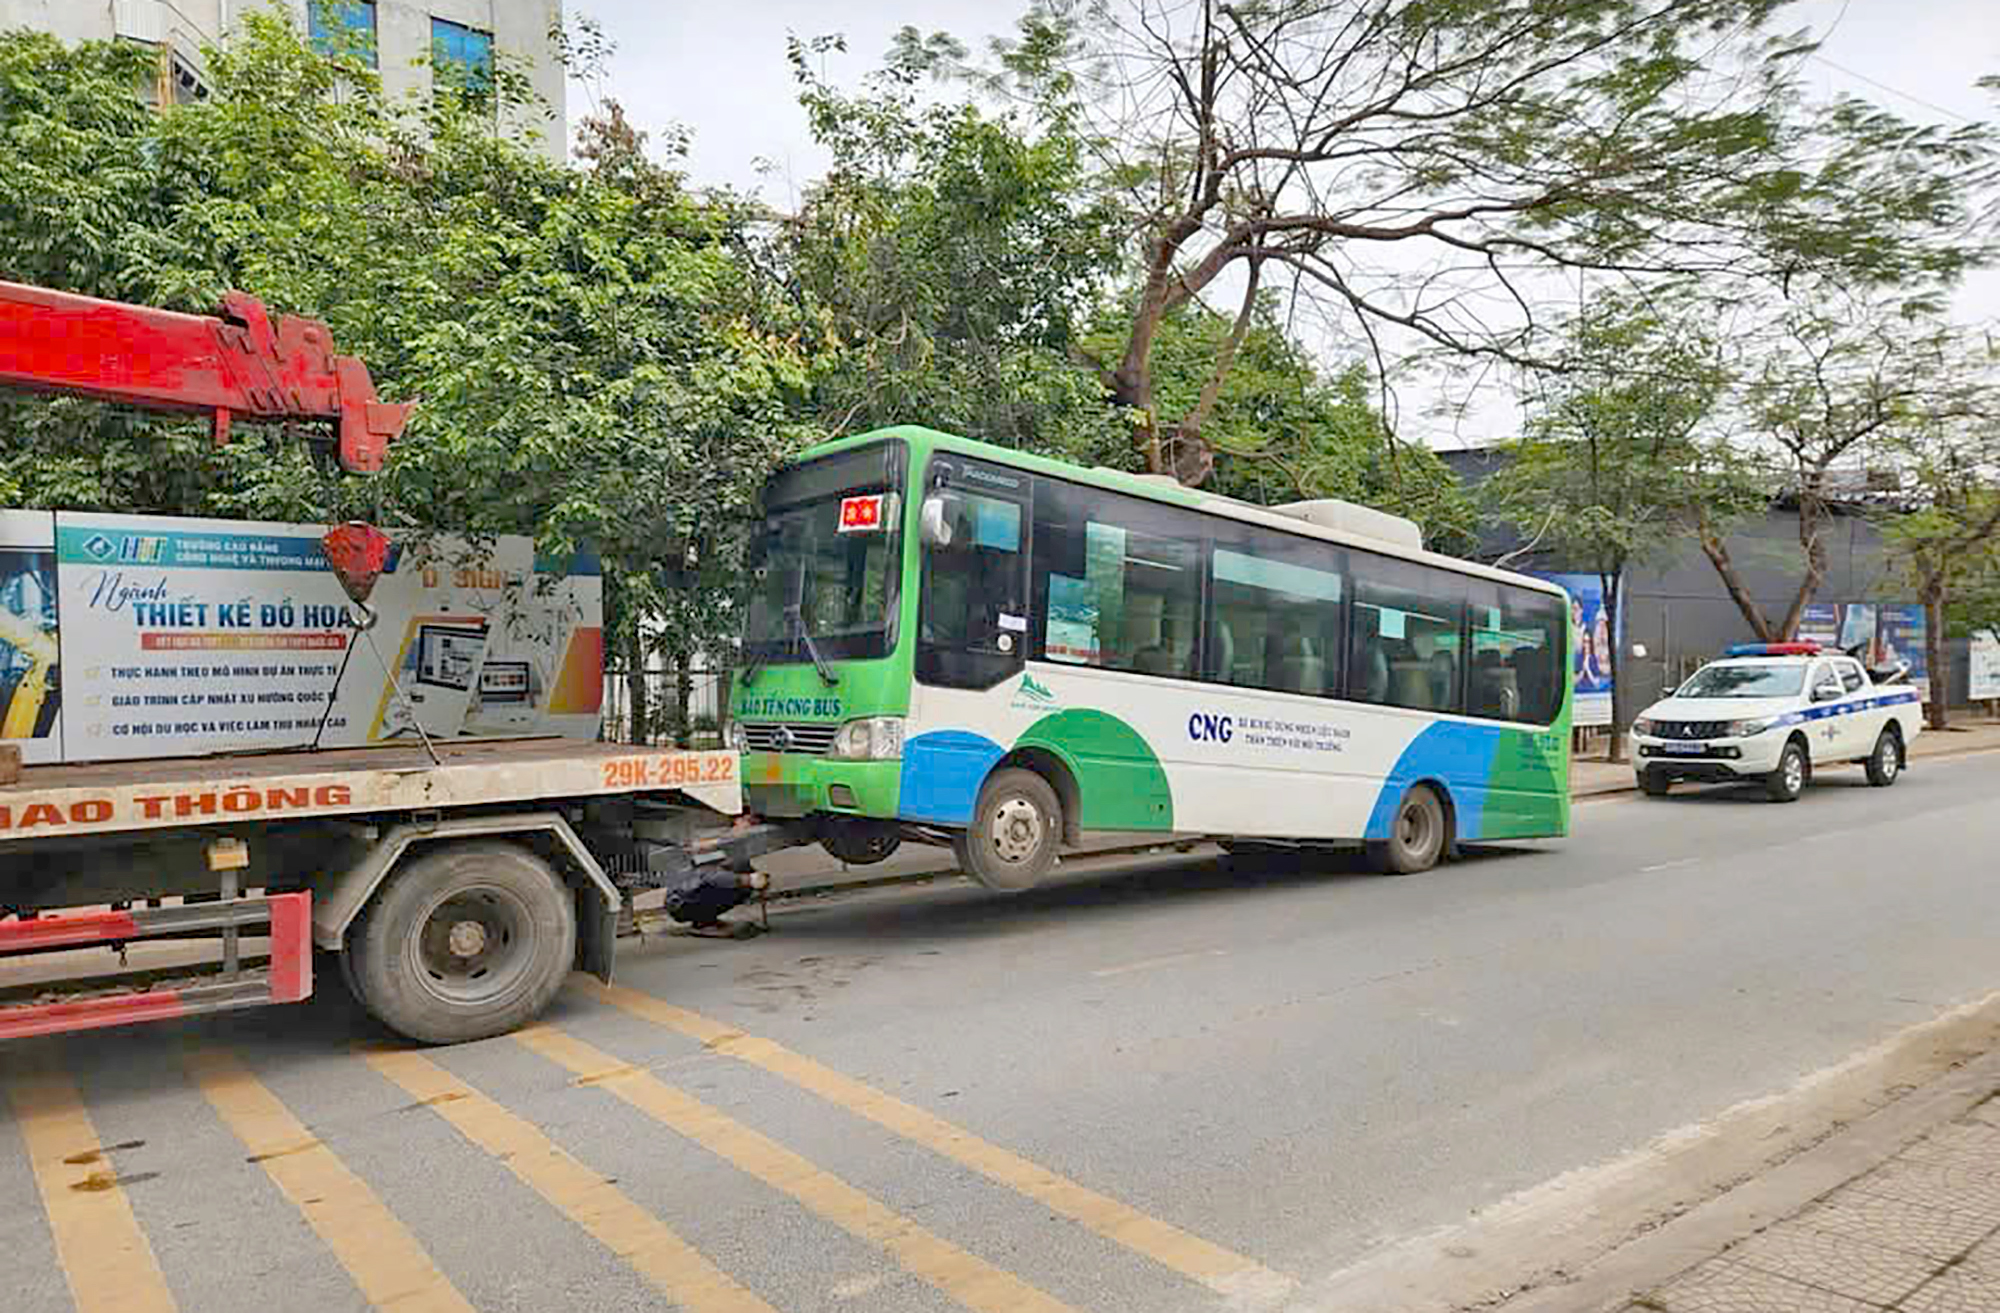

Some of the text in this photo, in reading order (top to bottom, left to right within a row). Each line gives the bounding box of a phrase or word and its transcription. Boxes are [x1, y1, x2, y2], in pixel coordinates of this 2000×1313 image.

[90, 571, 168, 612] Ngành
[134, 596, 351, 632] THIẾT KẾ ĐỒ HỌA
[181, 667, 209, 677] THEO
[814, 697, 841, 717] BUS
[1189, 712, 1233, 743] CNG
[604, 755, 734, 787] 29K-295.22
[133, 785, 352, 819] THÔNG
